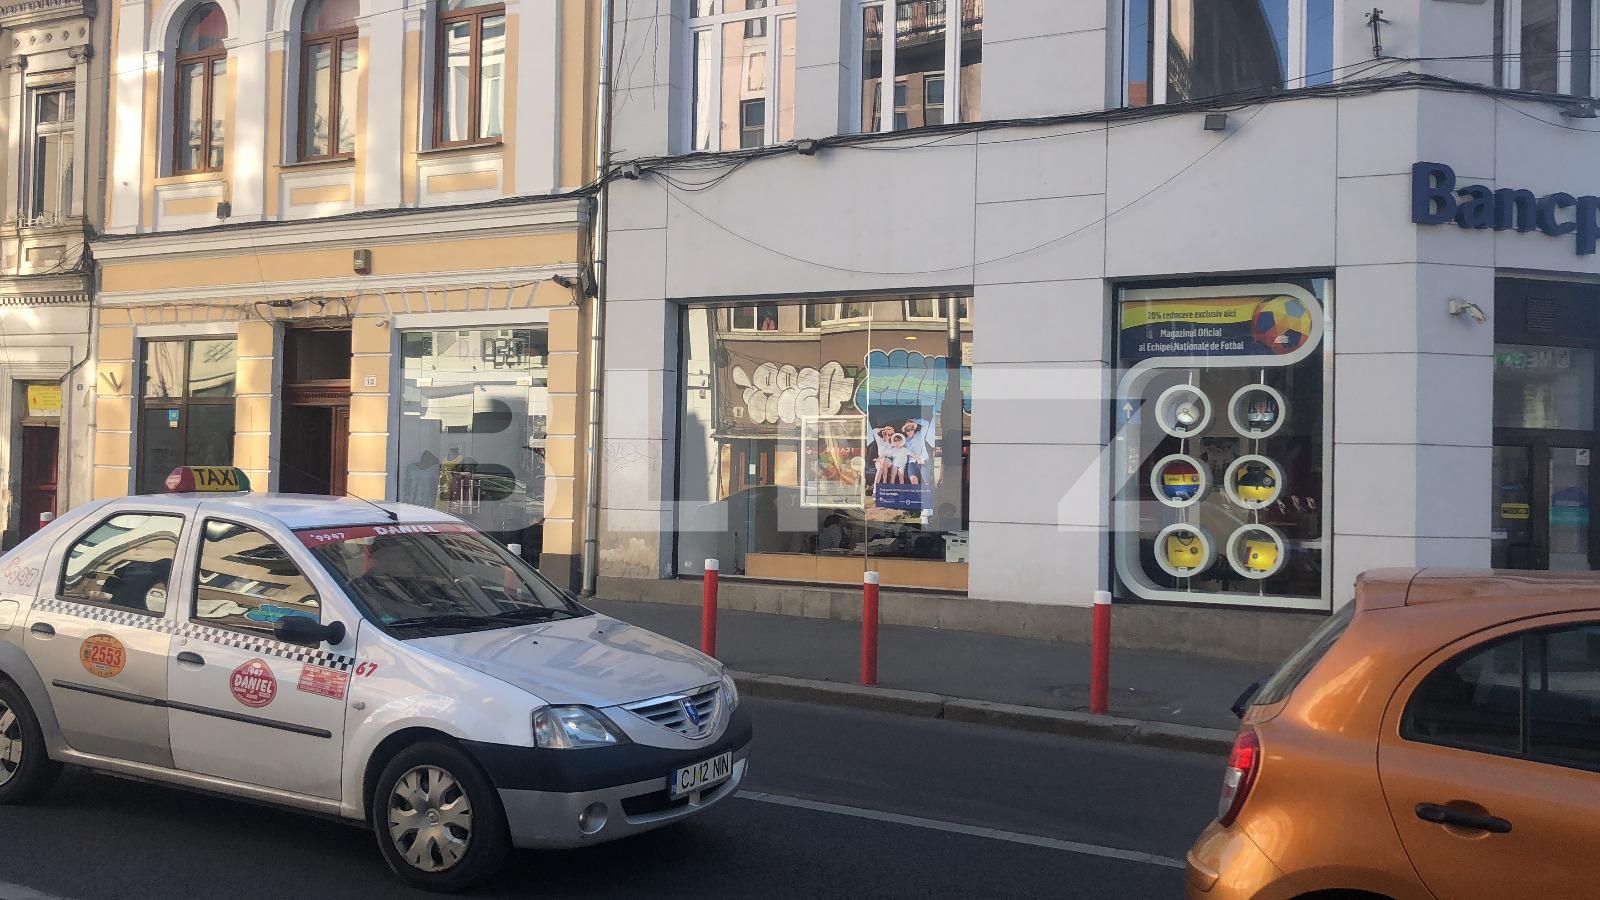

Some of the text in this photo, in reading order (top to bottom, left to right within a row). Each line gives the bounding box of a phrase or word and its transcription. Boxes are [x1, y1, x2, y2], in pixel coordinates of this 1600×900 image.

[1147, 309, 1237, 320] 20% reducere exclusiv aici
[1160, 327, 1222, 339] Magazinul Oficial
[1138, 344, 1146, 352] al
[1147, 342, 1173, 352] Echipei
[1210, 341, 1220, 351] de
[1220, 340, 1245, 350] Fotbal
[192, 468, 239, 486] TAXI
[372, 524, 440, 536] DANIEL
[90, 645, 122, 666] 2553
[356, 660, 378, 678] 67
[234, 674, 273, 694] DANIEL
[681, 766, 696, 790] CJ
[699, 762, 709, 783] 12
